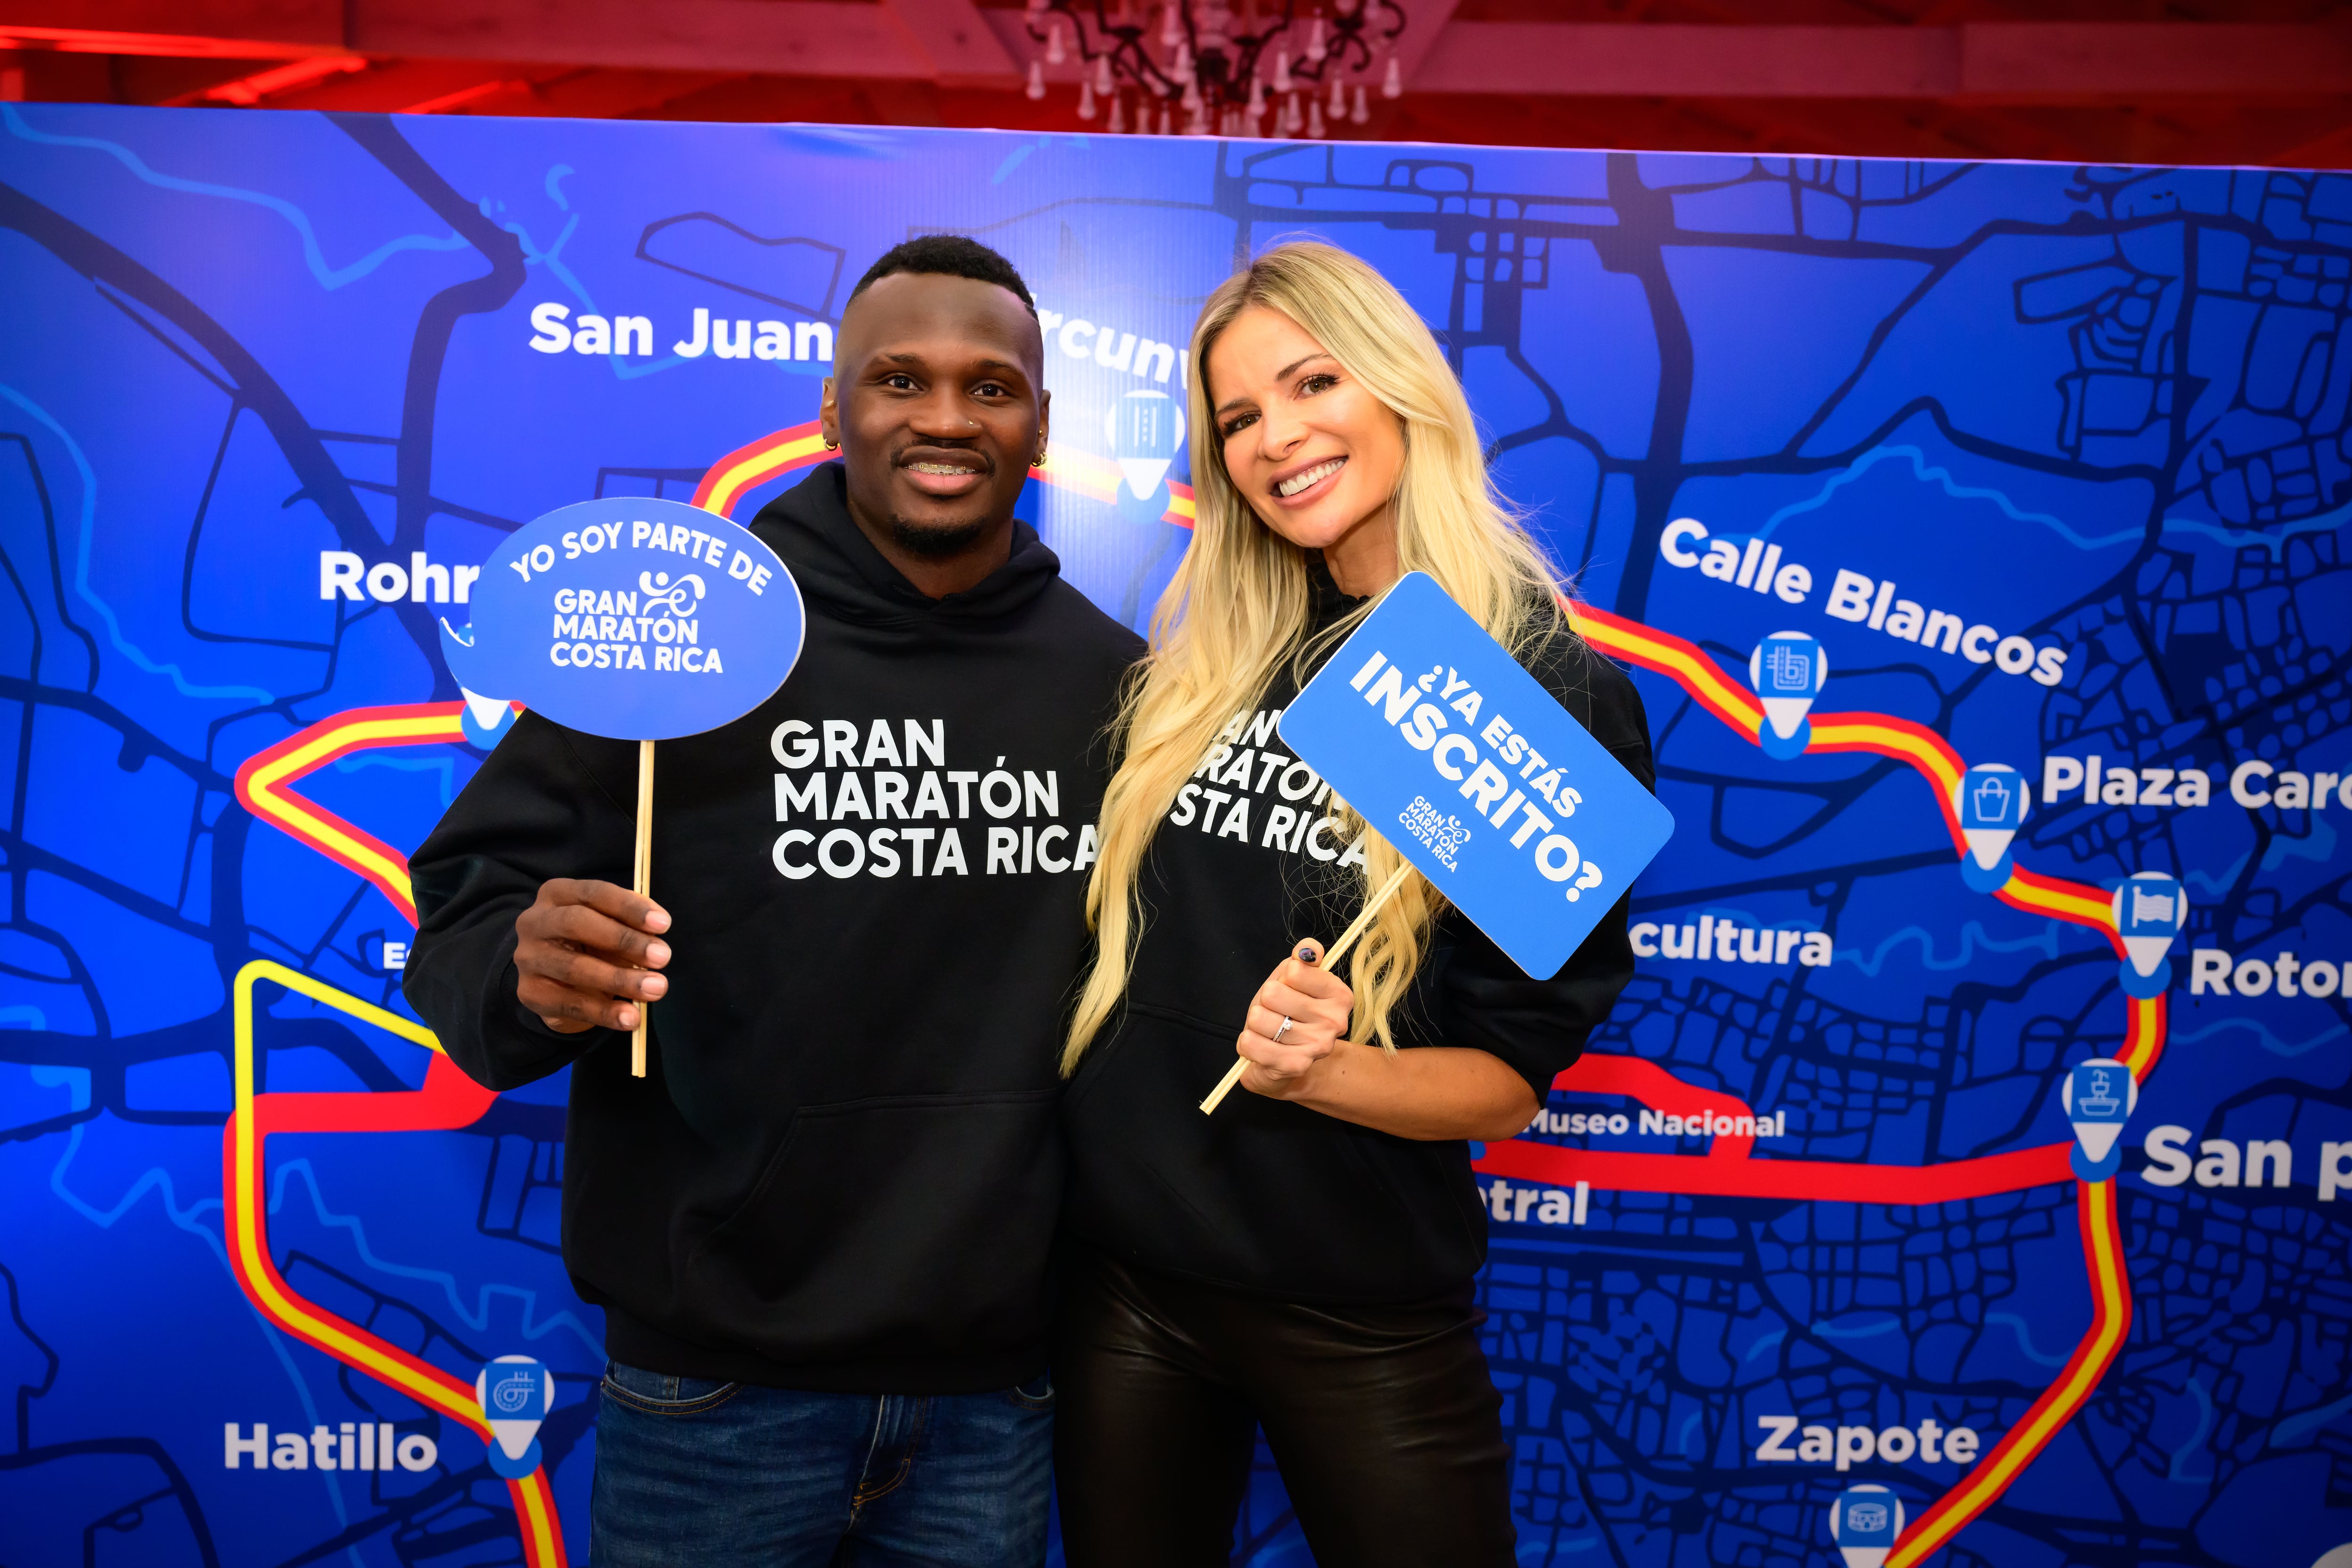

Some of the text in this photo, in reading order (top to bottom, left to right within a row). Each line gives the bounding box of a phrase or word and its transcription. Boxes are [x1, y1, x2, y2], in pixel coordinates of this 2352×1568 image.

[528, 302, 834, 361] San Juan
[1030, 292, 1189, 390] rcun
[320, 550, 480, 604] Rohr
[509, 521, 773, 597] YO SOY PARTE DE
[553, 611, 699, 644] MARATÓN
[554, 588, 637, 616] GRAN
[1660, 517, 2067, 686] Calle Blancos
[550, 641, 723, 673] COSTA RICA
[771, 719, 945, 769] GRAN
[1418, 665, 1582, 818] ¿YA ESTÁS
[774, 756, 1059, 821] MARATÓN
[1350, 650, 1603, 902] INSCRITO?
[2042, 756, 2210, 807] Plaza
[1169, 783, 1368, 875] STA RICA
[1406, 802, 1459, 855] MARATÓN
[1414, 795, 1446, 827] GRAN
[772, 824, 1099, 880] COSTA RICA
[1398, 812, 1458, 873] COSTA RICA
[383, 942, 412, 969] E
[1628, 915, 1832, 966] cultura
[1639, 1109, 1785, 1137] Nacional
[2141, 1125, 2292, 1187] San
[1478, 1180, 1589, 1225] tral
[224, 1423, 438, 1472] Hatillo
[1756, 1416, 1979, 1471] Zapote
